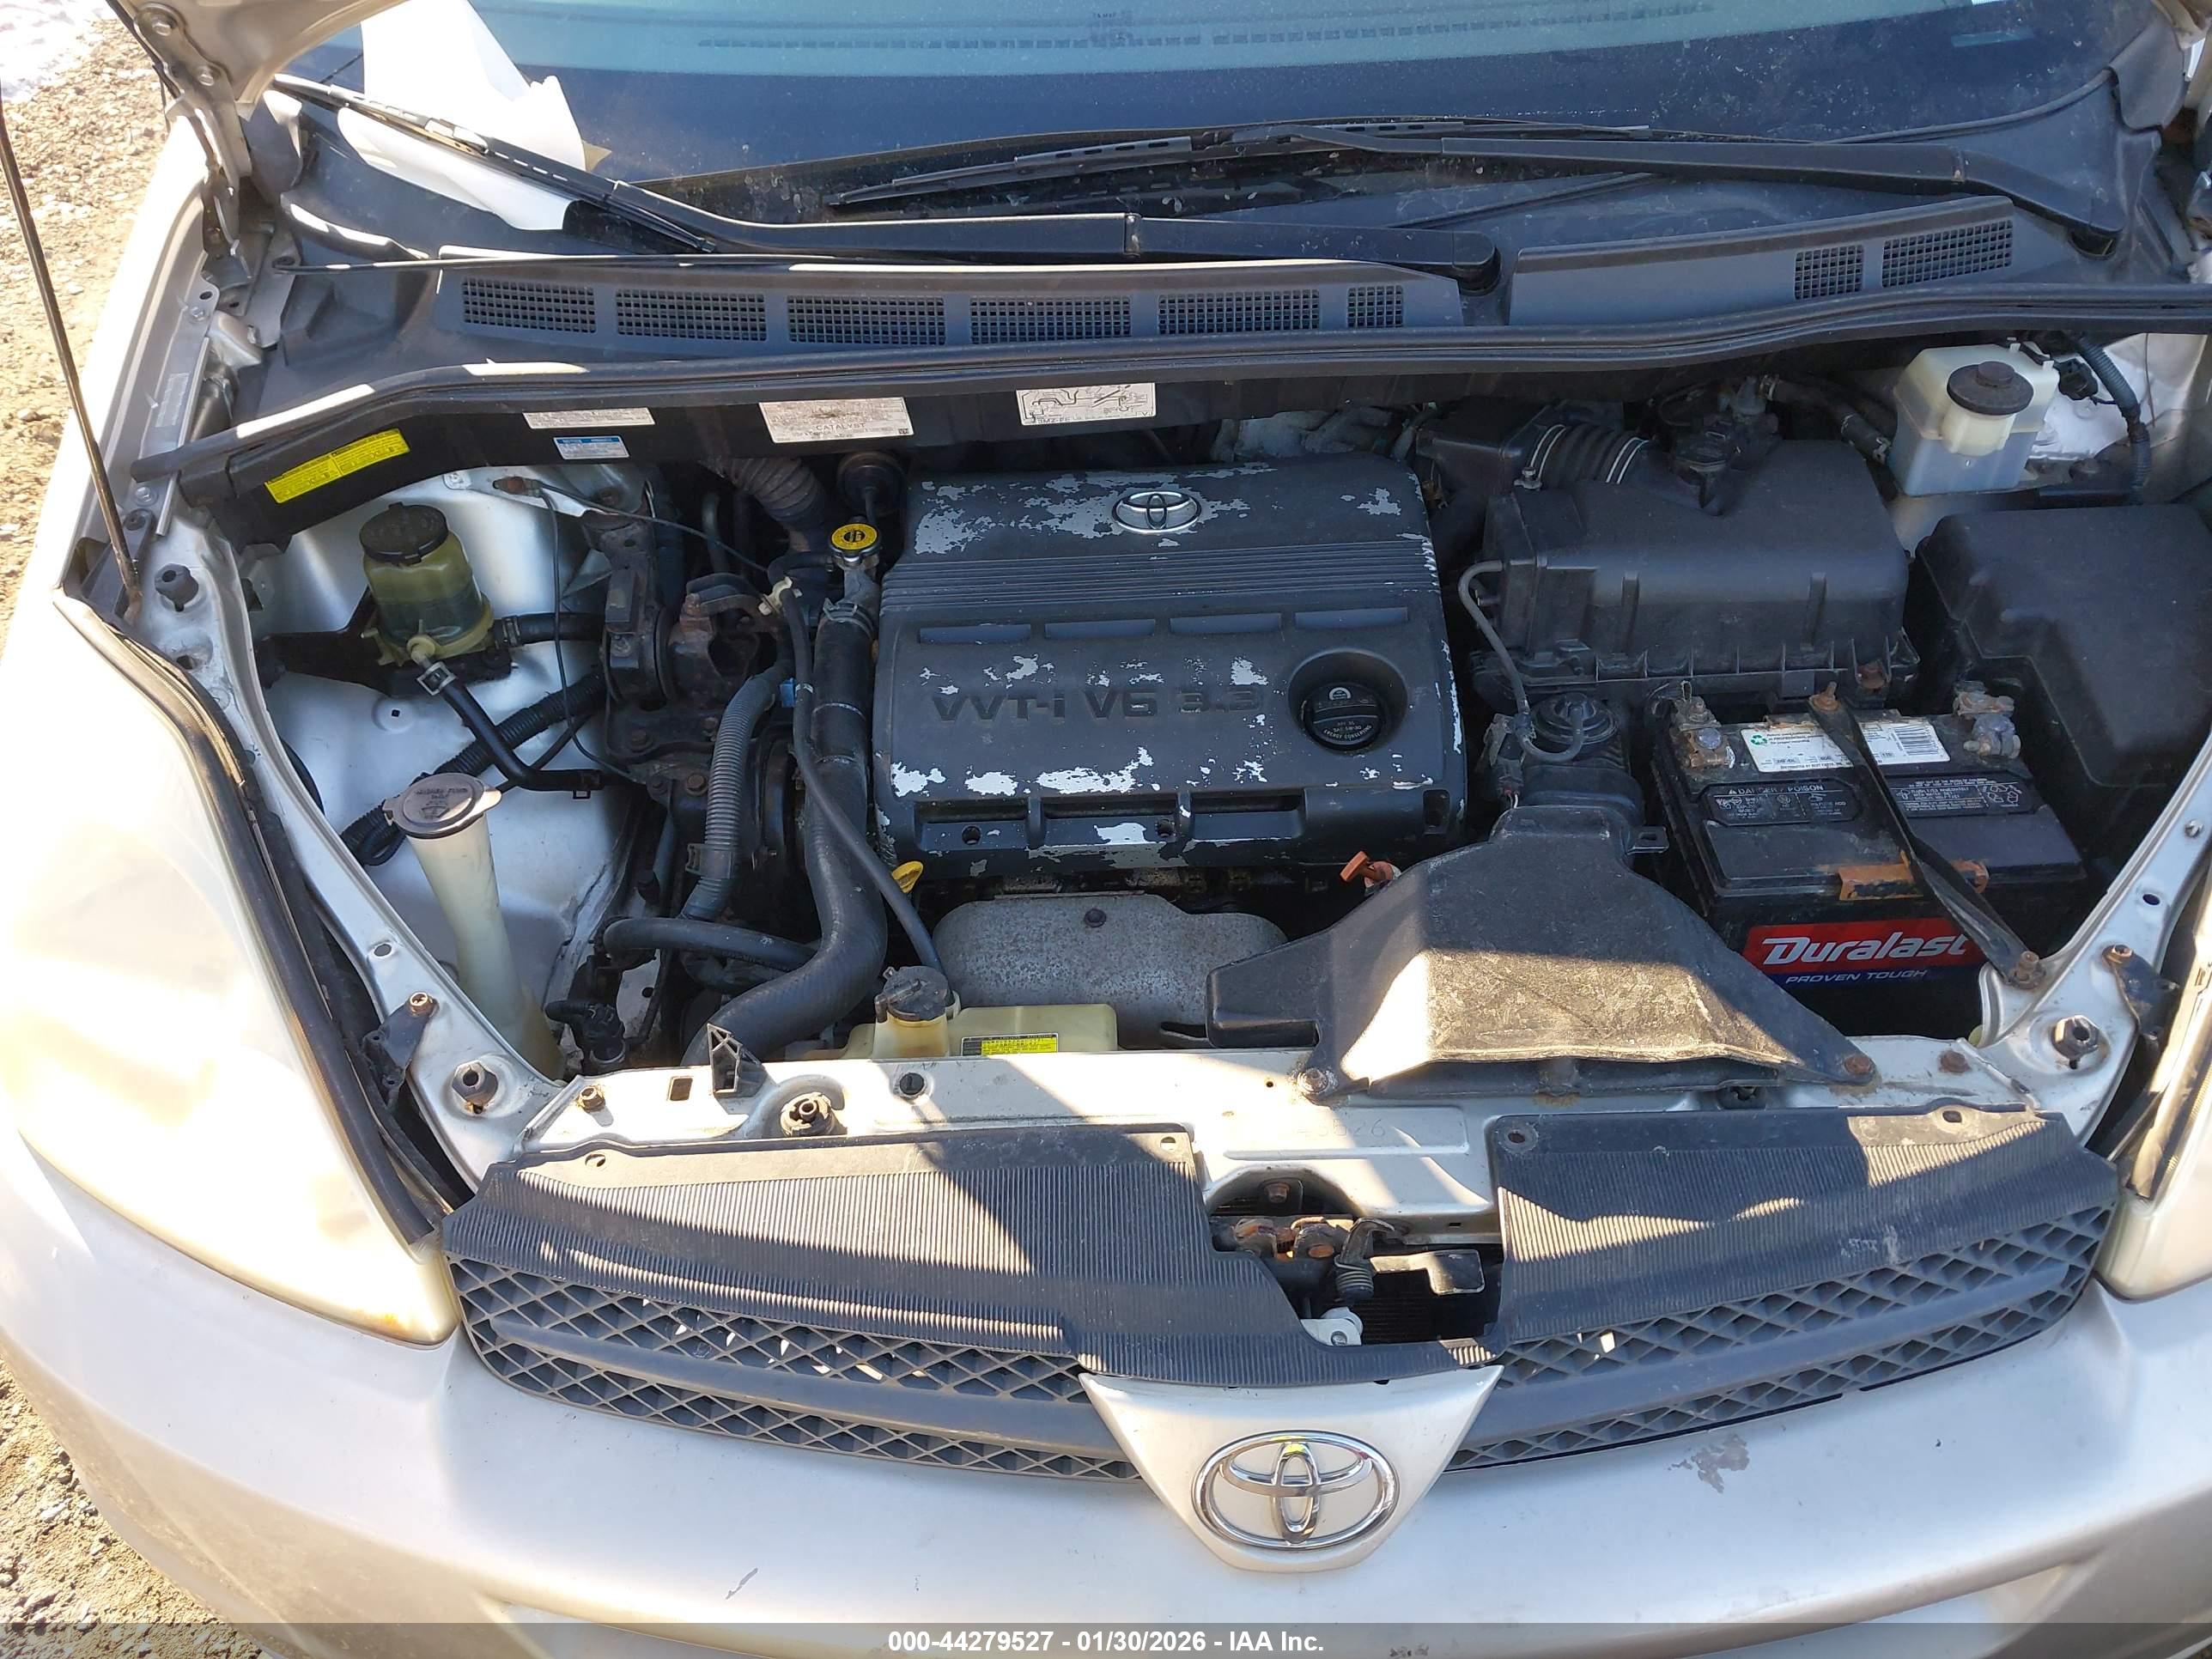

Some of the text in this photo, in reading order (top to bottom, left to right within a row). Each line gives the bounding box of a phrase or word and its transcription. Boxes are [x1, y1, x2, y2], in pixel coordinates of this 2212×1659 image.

[1084, 687, 1159, 720] V6
[1762, 932, 1969, 966] Duralast
[1785, 969, 1928, 984] PROVEN TOUGH
